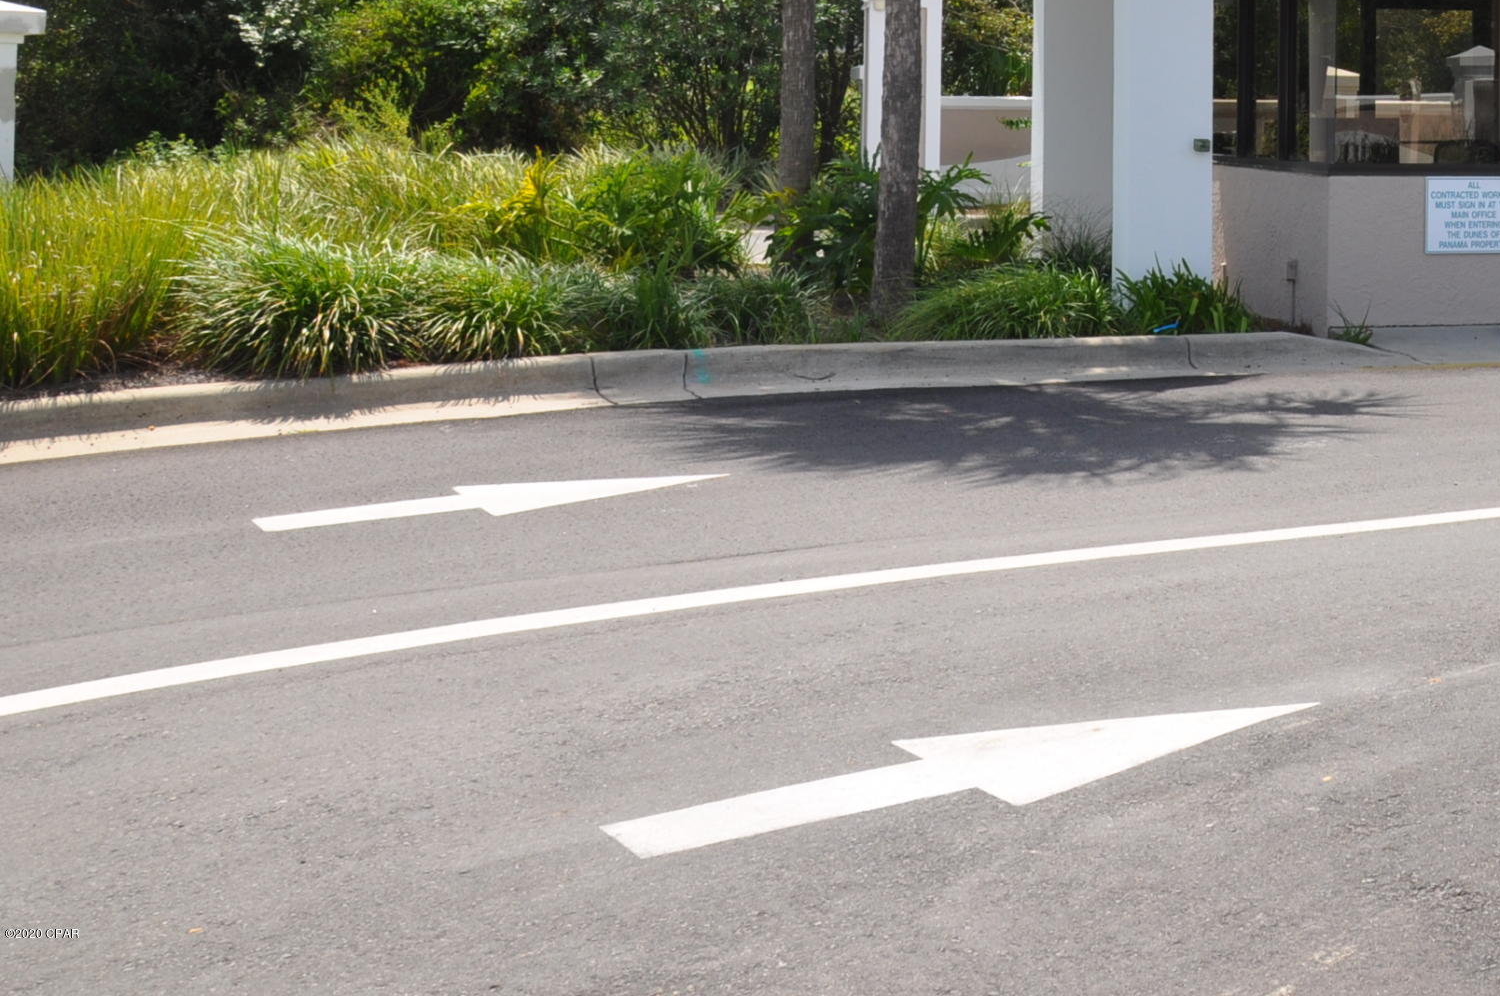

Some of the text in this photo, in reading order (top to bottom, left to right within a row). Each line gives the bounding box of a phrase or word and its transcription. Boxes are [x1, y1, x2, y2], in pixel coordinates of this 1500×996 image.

[1467, 181, 1480, 189] ALL
[1430, 191, 1479, 199] CONTRACTED
[1435, 201, 1455, 209] MUST
[1459, 201, 1476, 209] SIGN
[1477, 201, 1486, 209] IN
[1487, 201, 1497, 209] AT
[1451, 211, 1497, 219] MAIN OFFICE
[1444, 221, 1466, 229] WHEN
[1447, 231, 1500, 239] THE DUNES OF
[1438, 241, 1468, 249] PANAMA
